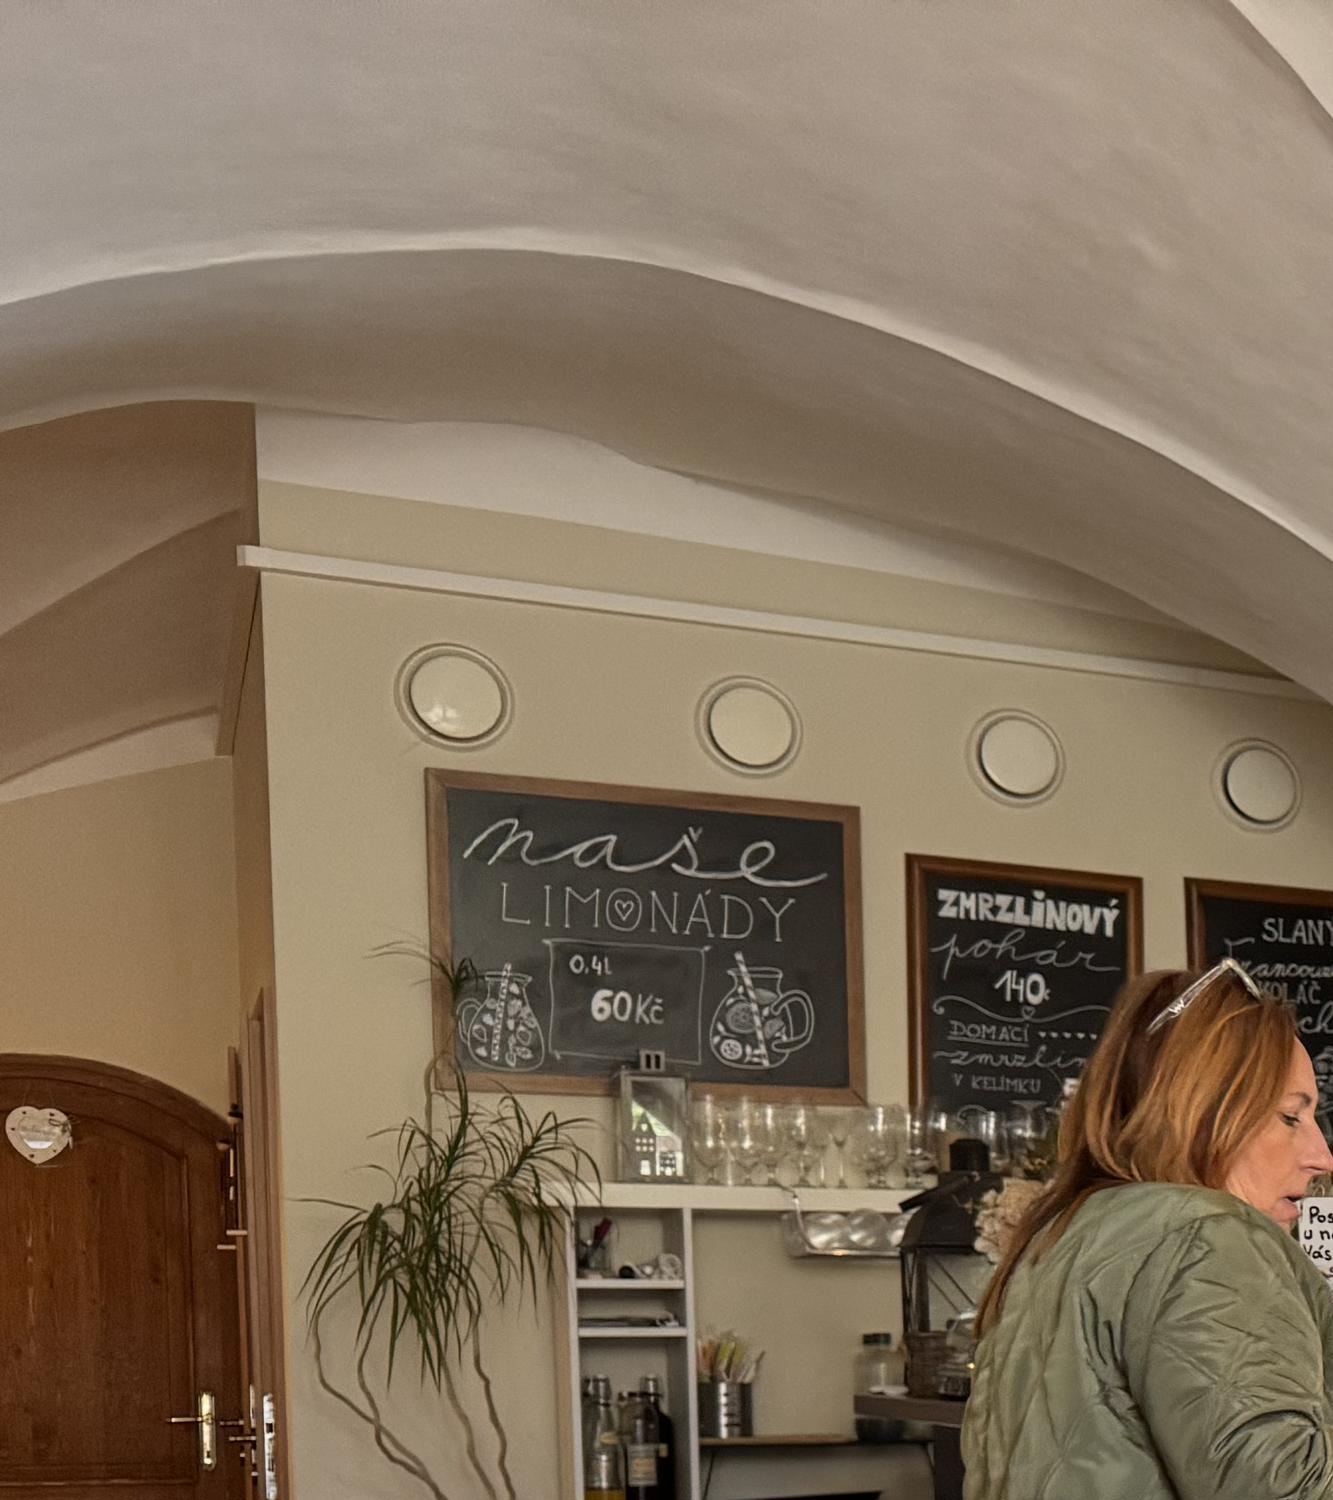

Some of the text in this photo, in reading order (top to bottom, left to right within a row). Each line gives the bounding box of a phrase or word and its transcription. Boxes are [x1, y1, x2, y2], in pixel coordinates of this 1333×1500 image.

[463, 818, 828, 887] naše
[501, 883, 796, 943] LIMONÁDY
[931, 927, 1121, 981] pohár
[933, 1045, 1087, 1068] zmrzlin
[1303, 1230, 1313, 1240] u
